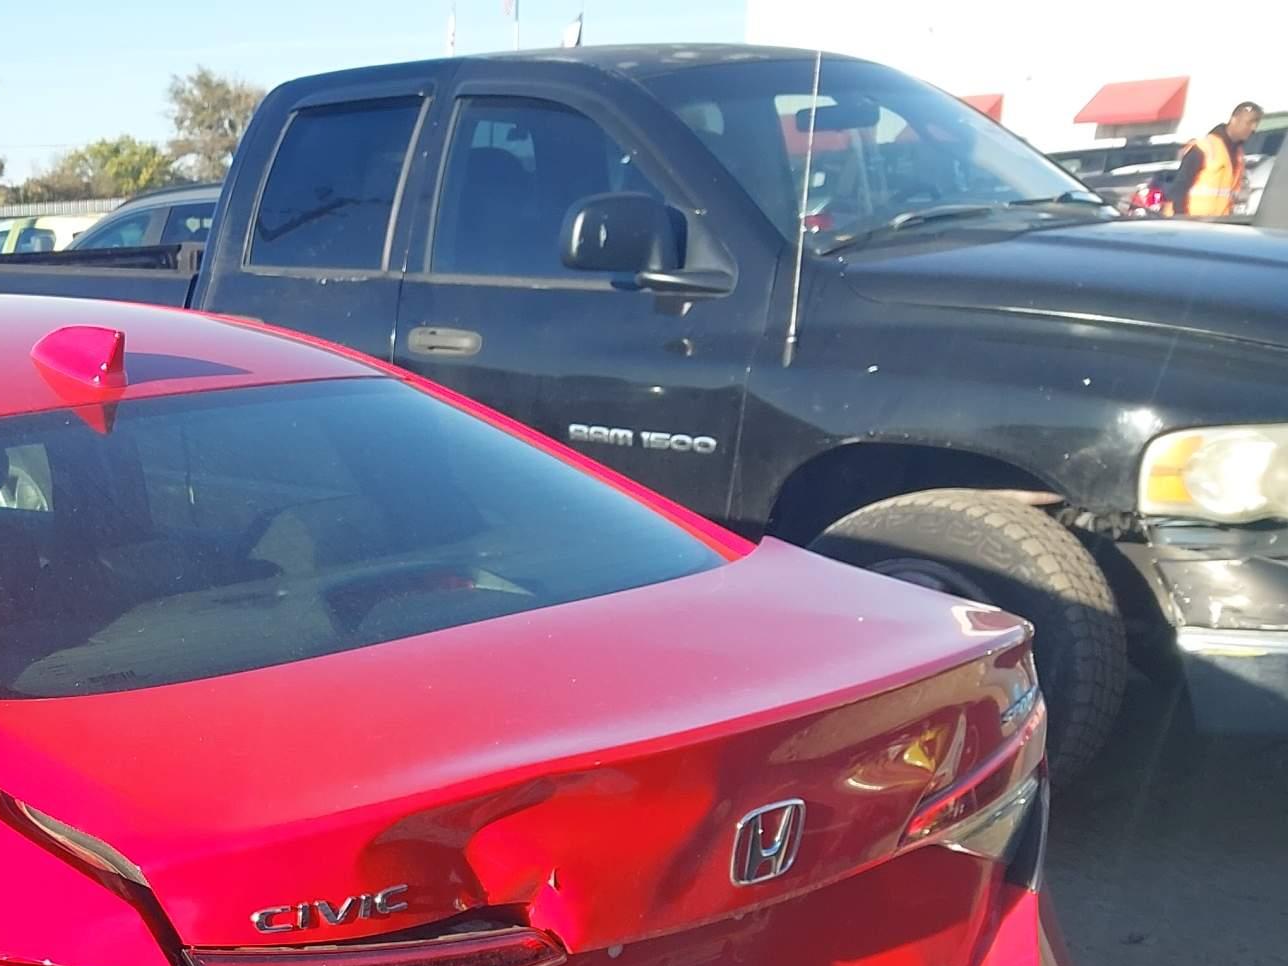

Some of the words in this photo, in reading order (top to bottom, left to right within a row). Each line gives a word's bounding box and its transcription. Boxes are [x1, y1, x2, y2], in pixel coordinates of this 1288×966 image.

[569, 424, 633, 447] RAM
[640, 431, 717, 453] 1500
[250, 884, 408, 934] CIVIC
